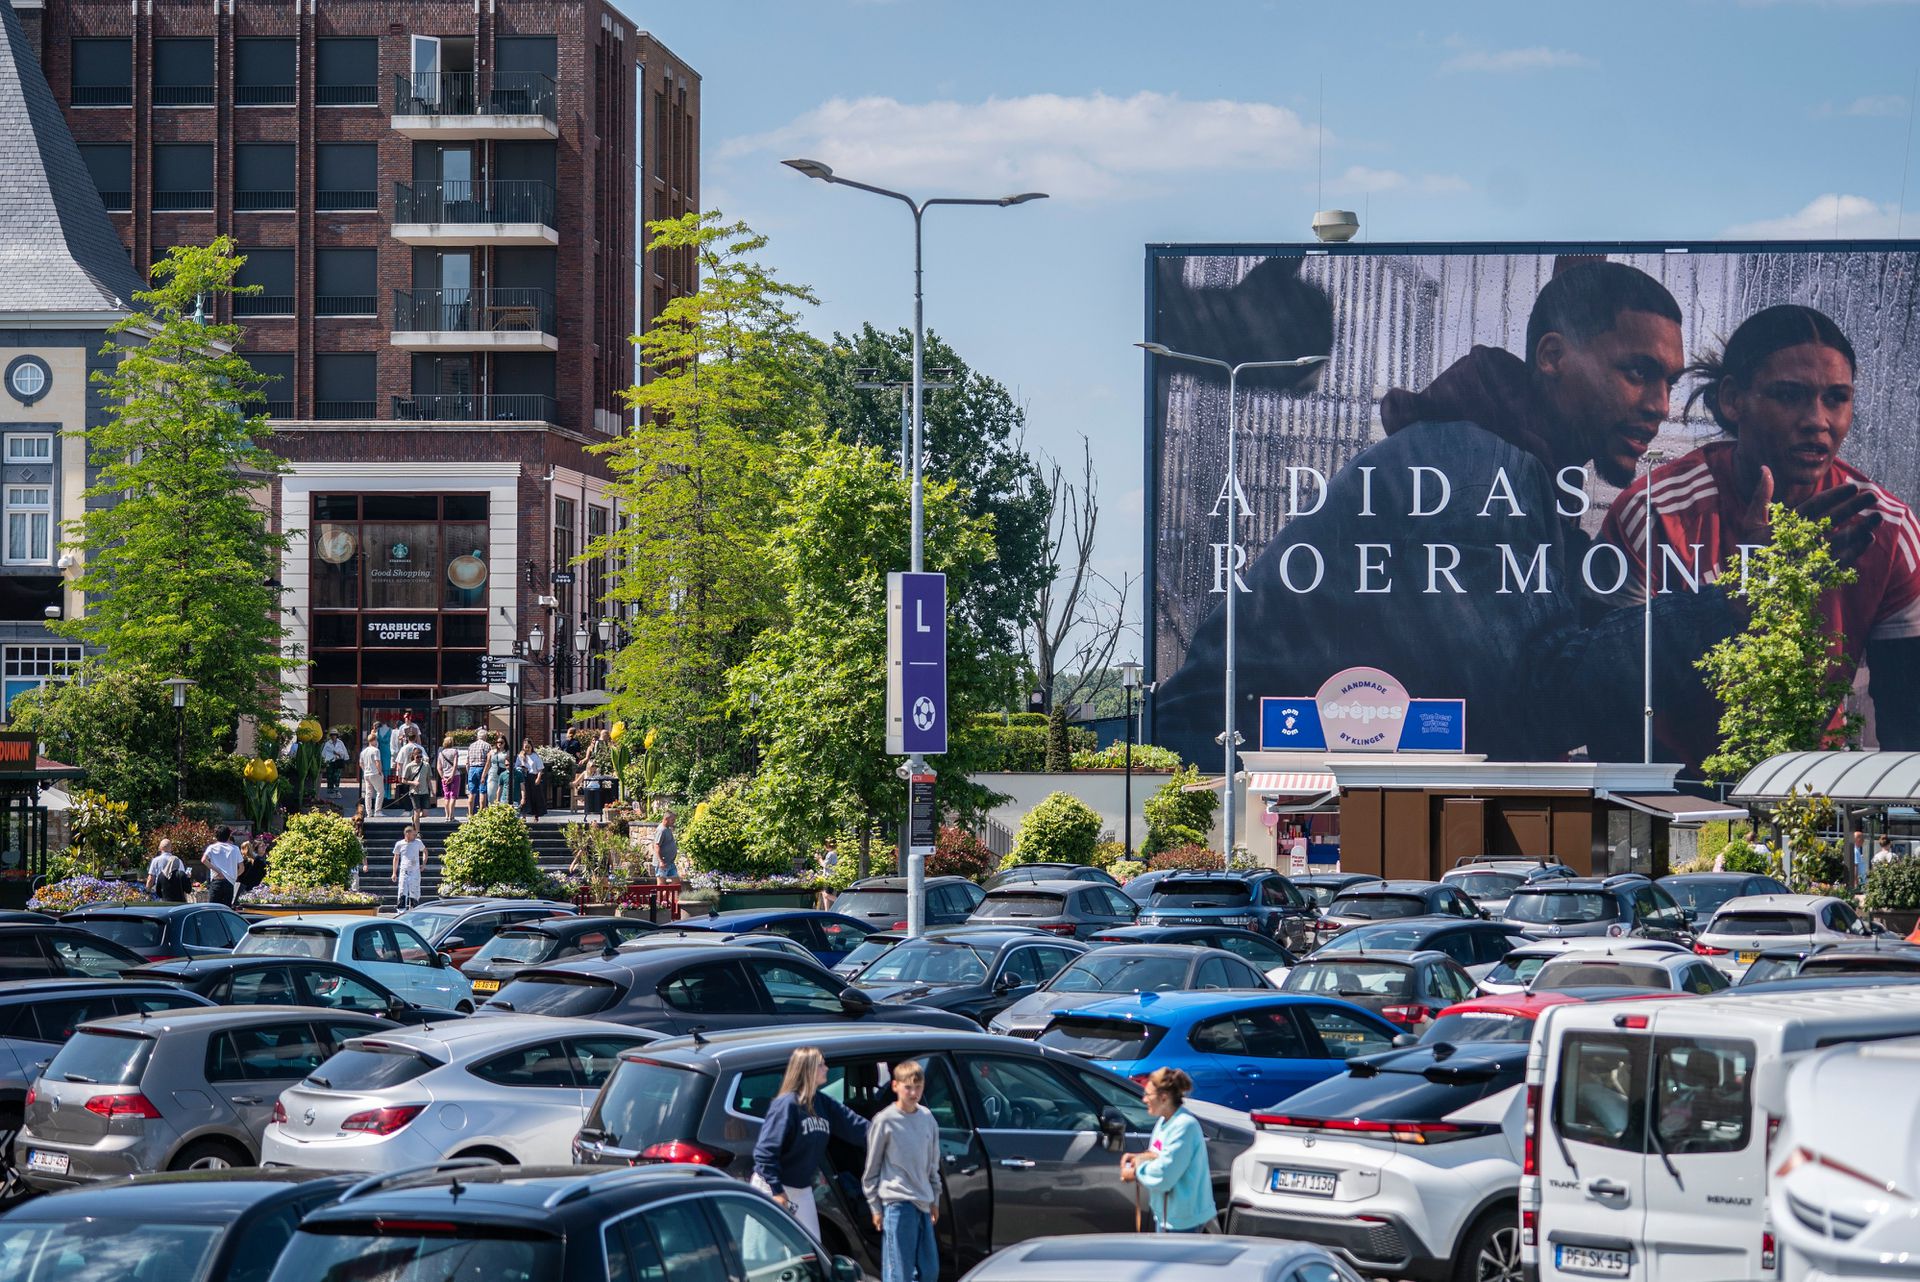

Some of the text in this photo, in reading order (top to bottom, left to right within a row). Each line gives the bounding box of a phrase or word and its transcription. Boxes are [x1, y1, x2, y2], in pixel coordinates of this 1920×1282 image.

[1207, 466, 1590, 516] ADIDAS
[371, 568, 431, 578] Good Shopping
[916, 599, 931, 633] L
[368, 622, 432, 631] STARBUCKS
[379, 631, 420, 640] COFFEE
[1341, 681, 1388, 694] HANDMADE
[1281, 708, 1299, 716] nom
[1323, 700, 1402, 724] Crêpes
[1281, 728, 1299, 736] nom
[1340, 732, 1385, 745] BY KLINGER
[1549, 1179, 1581, 1190] TRAFIC
[1706, 1194, 1753, 1206] RENAULT
[1566, 1248, 1623, 1269] PF SK 15
